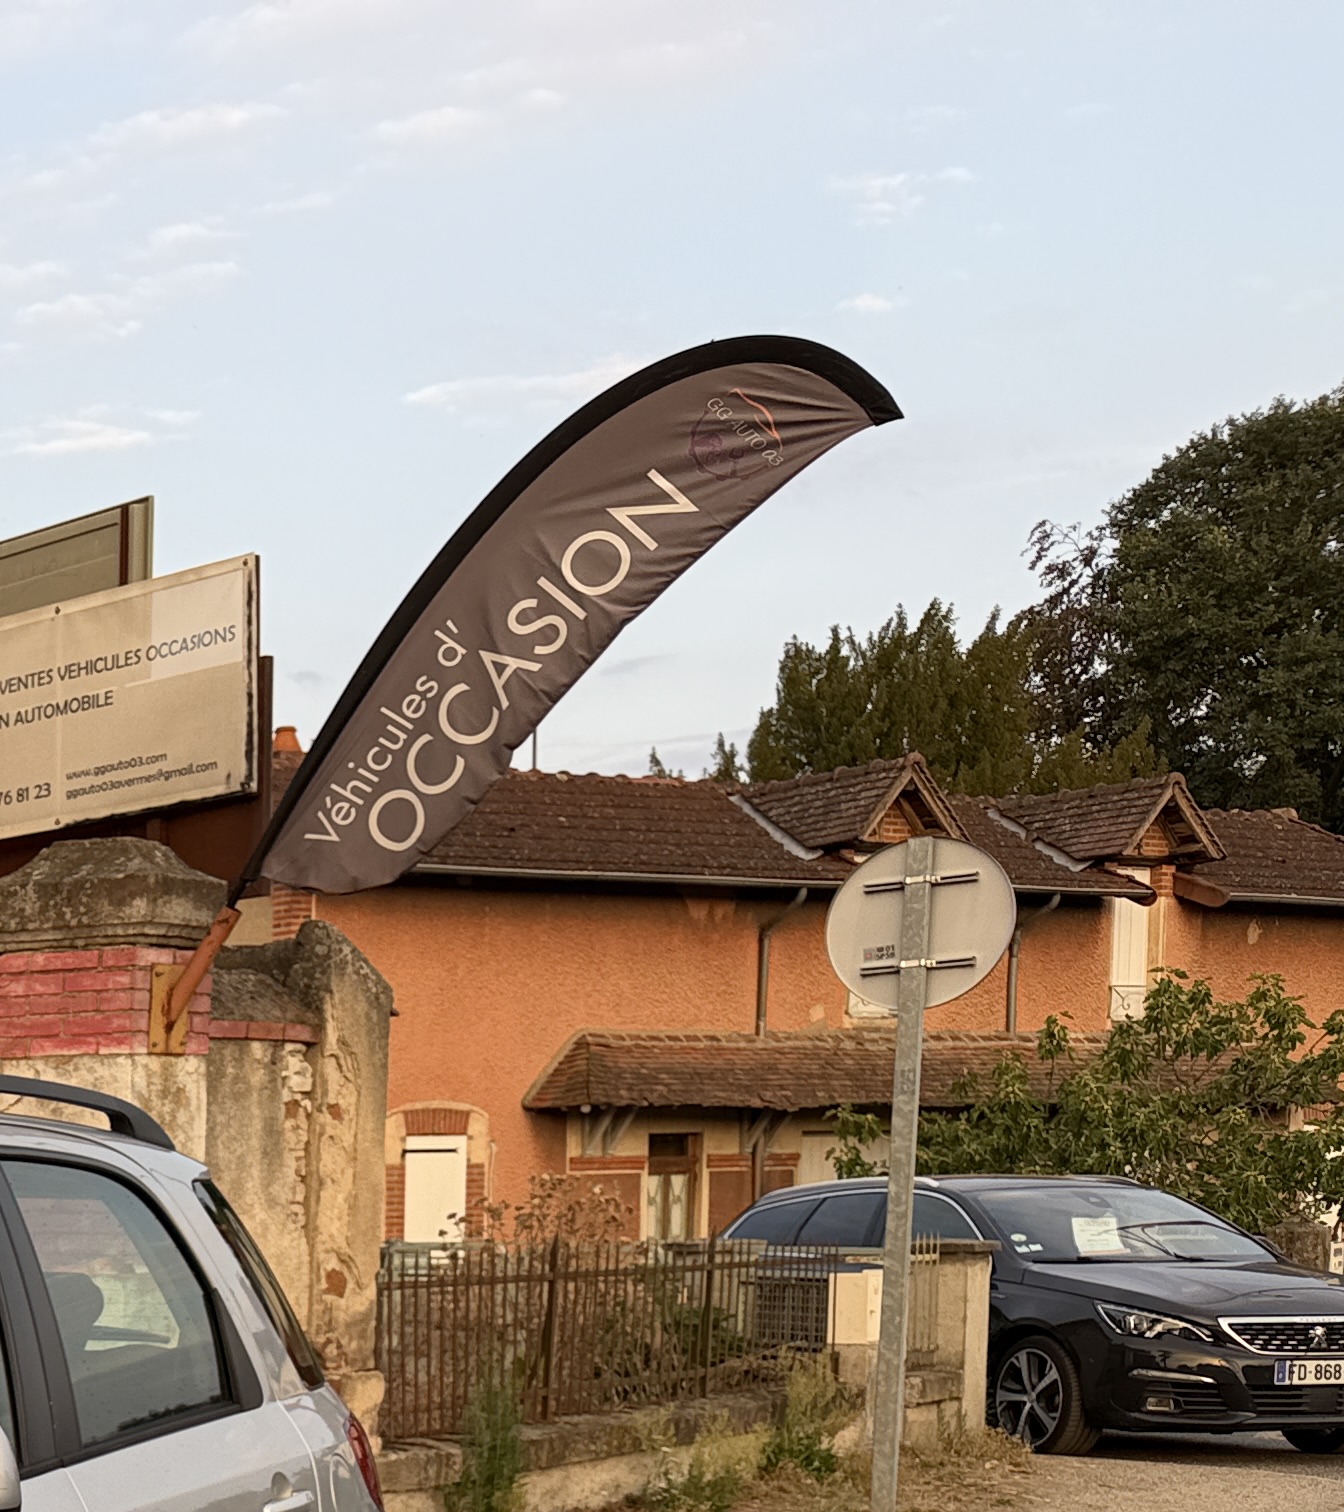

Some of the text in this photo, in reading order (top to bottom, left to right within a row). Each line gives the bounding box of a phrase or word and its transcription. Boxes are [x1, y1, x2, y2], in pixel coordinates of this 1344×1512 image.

[707, 398, 784, 466] GG AUTO 03
[57, 649, 141, 683] VEHICULES
[145, 625, 237, 661] OCCASIONS
[368, 468, 700, 852] OCCASION
[14, 690, 114, 726] AUTOMOBILE
[66, 753, 168, 781] www.ggauto03.com
[304, 674, 438, 846] Véhicules
[16, 788, 31, 805] 81
[34, 783, 51, 802] 23
